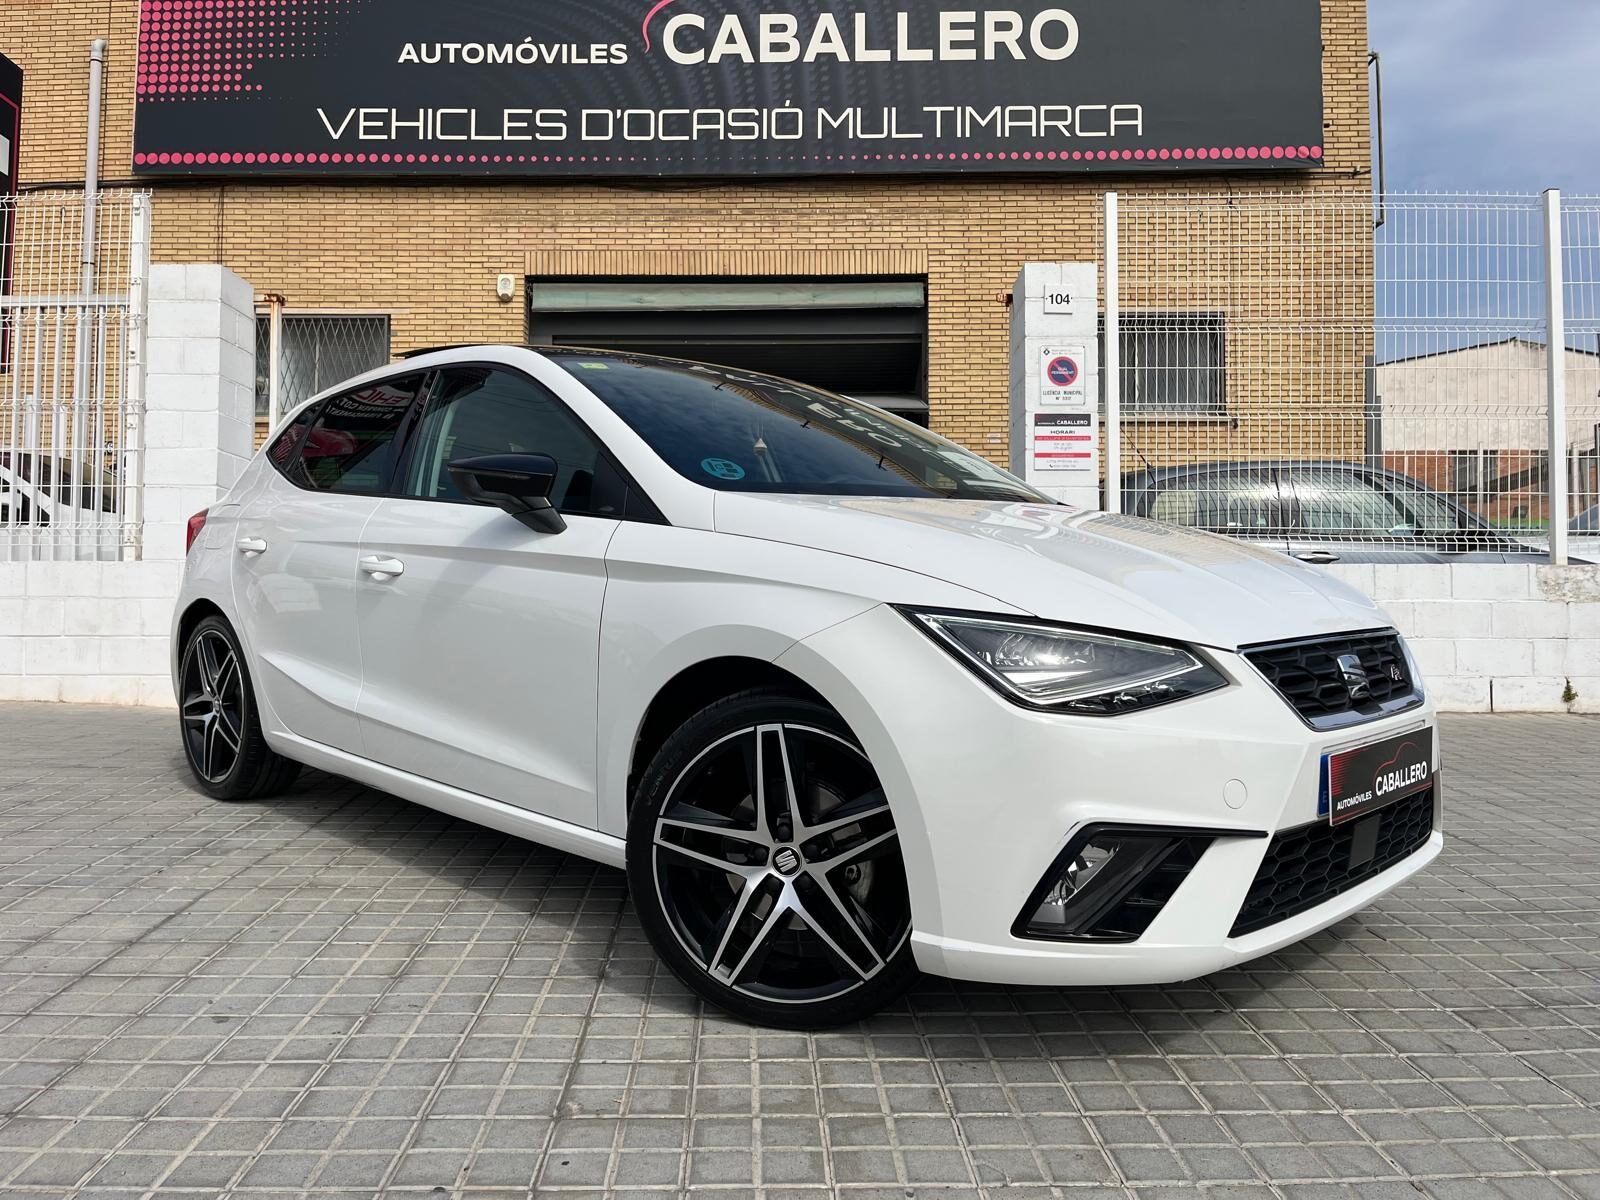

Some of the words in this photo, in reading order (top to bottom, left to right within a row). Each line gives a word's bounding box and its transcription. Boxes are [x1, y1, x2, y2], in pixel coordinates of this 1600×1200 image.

[397, 37, 628, 65] AUTOMÓVILES
[662, 9, 1079, 64] CABALLERO
[316, 108, 568, 141] VEHICLES
[581, 99, 803, 141] D'OCASIÓ
[817, 103, 1143, 140] MULTIMARCA
[1048, 293, 1071, 305] 104
[1336, 790, 1373, 811] AUTOMÓVILES
[1375, 761, 1428, 796] CABALLERO
